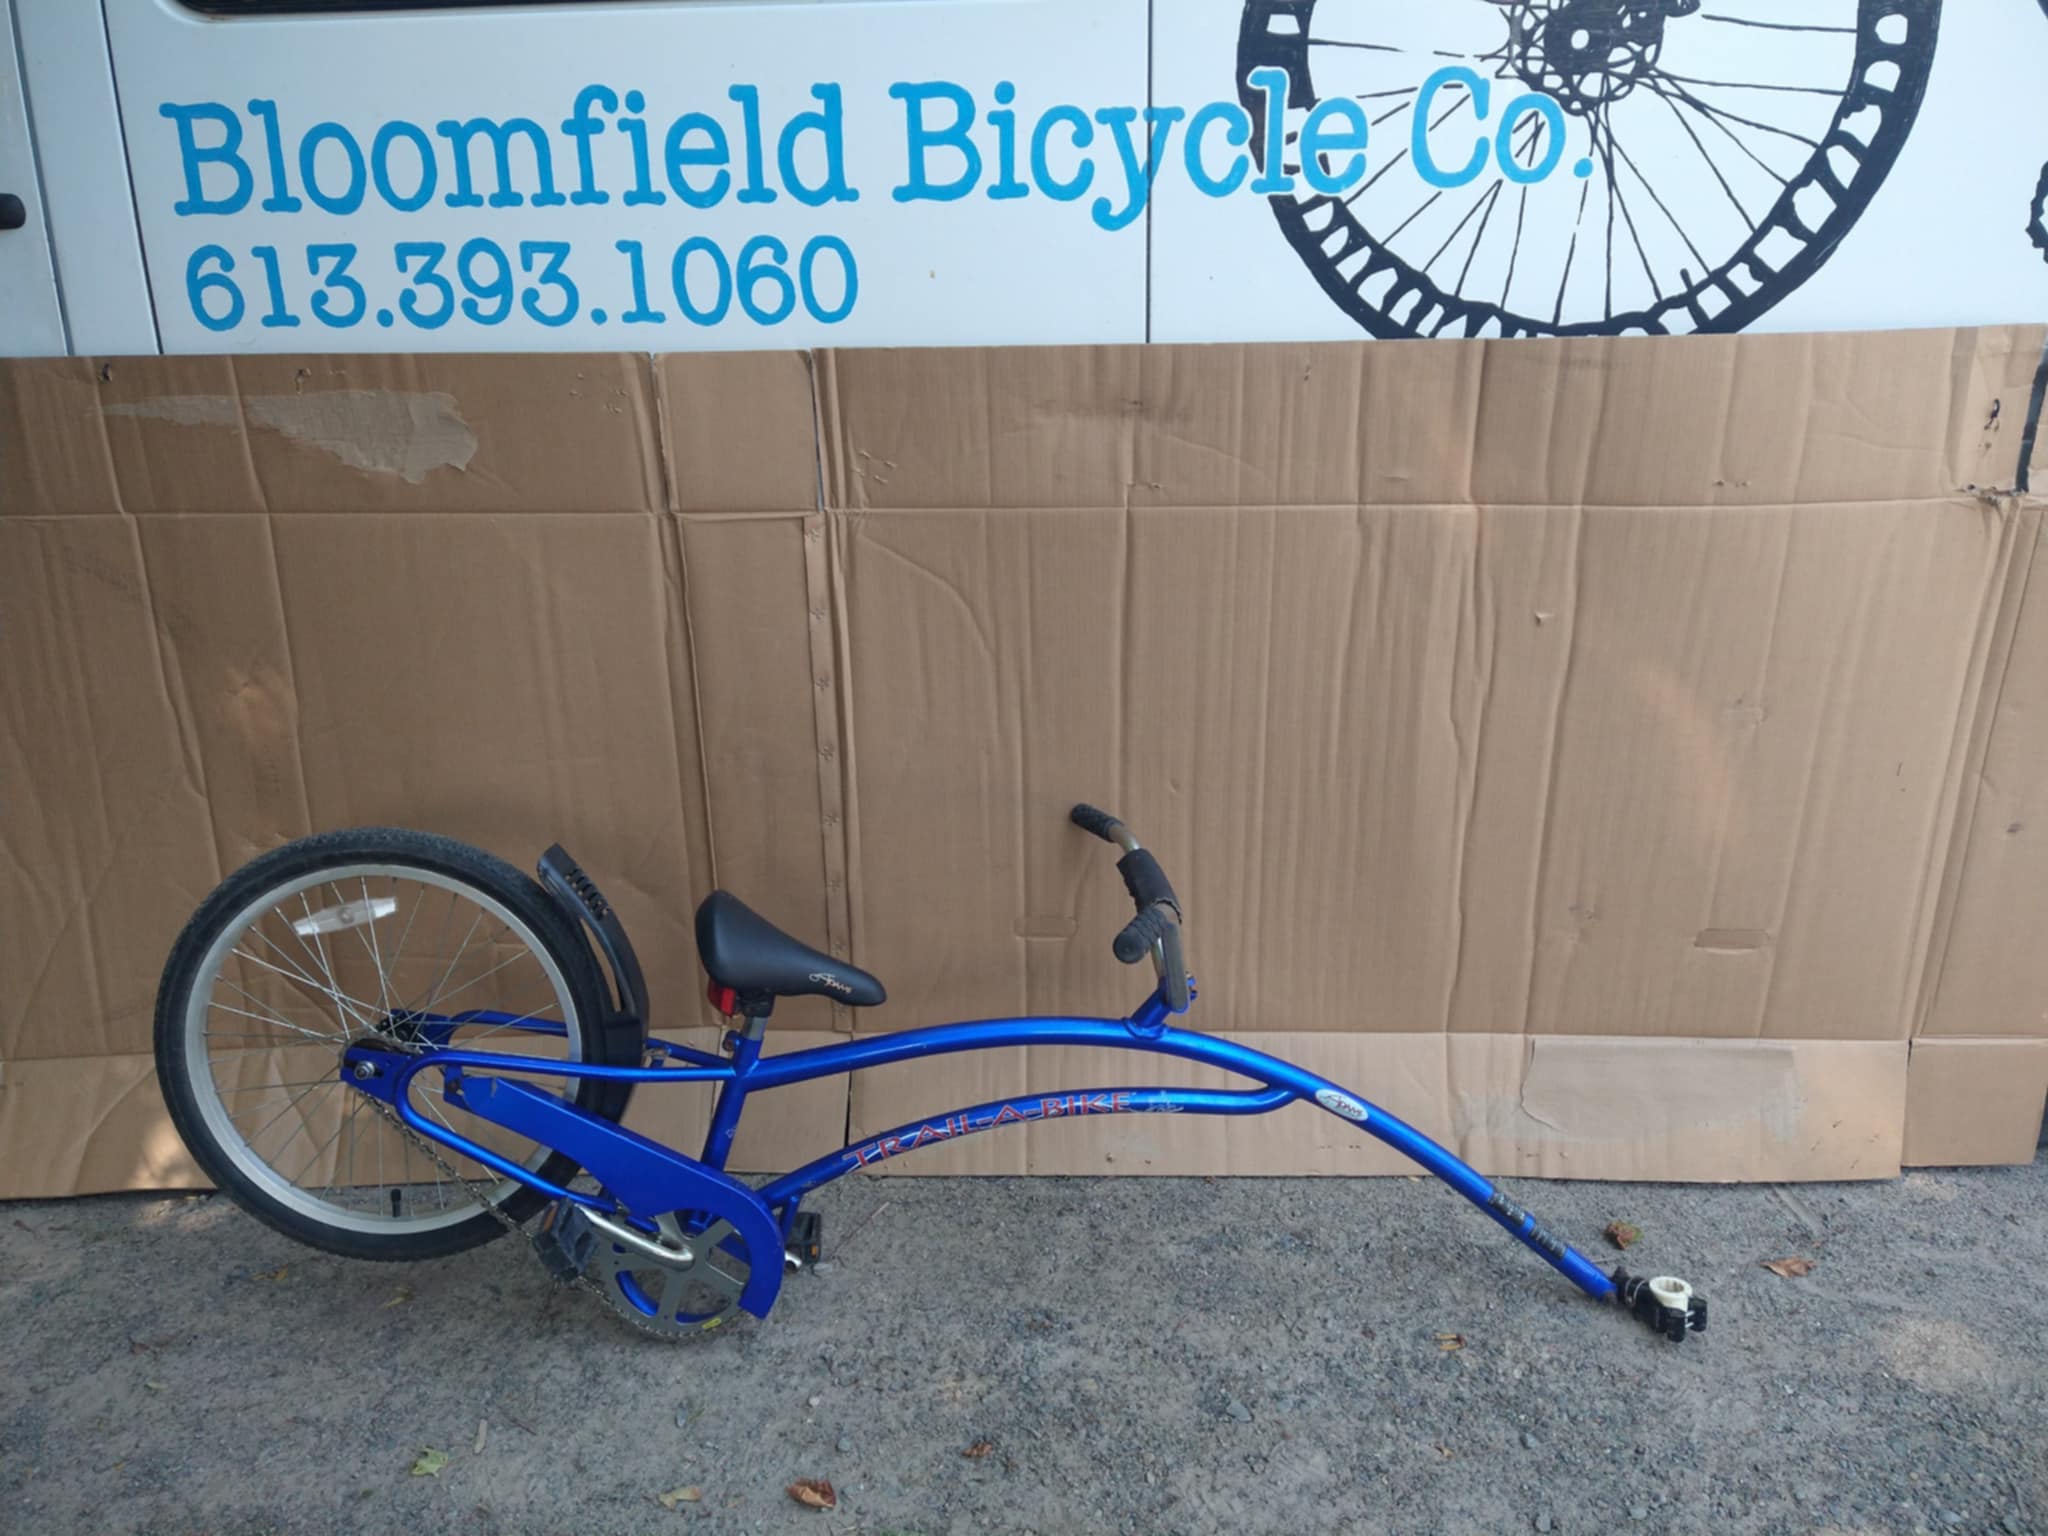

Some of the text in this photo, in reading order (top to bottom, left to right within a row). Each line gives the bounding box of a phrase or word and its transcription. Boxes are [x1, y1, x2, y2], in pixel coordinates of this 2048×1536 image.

[158, 65, 1594, 232] Bloomfield Bicycle Co.
[185, 234, 860, 332] 613.393.1060
[842, 1092, 1131, 1168] TRAIL-A-BIKE
